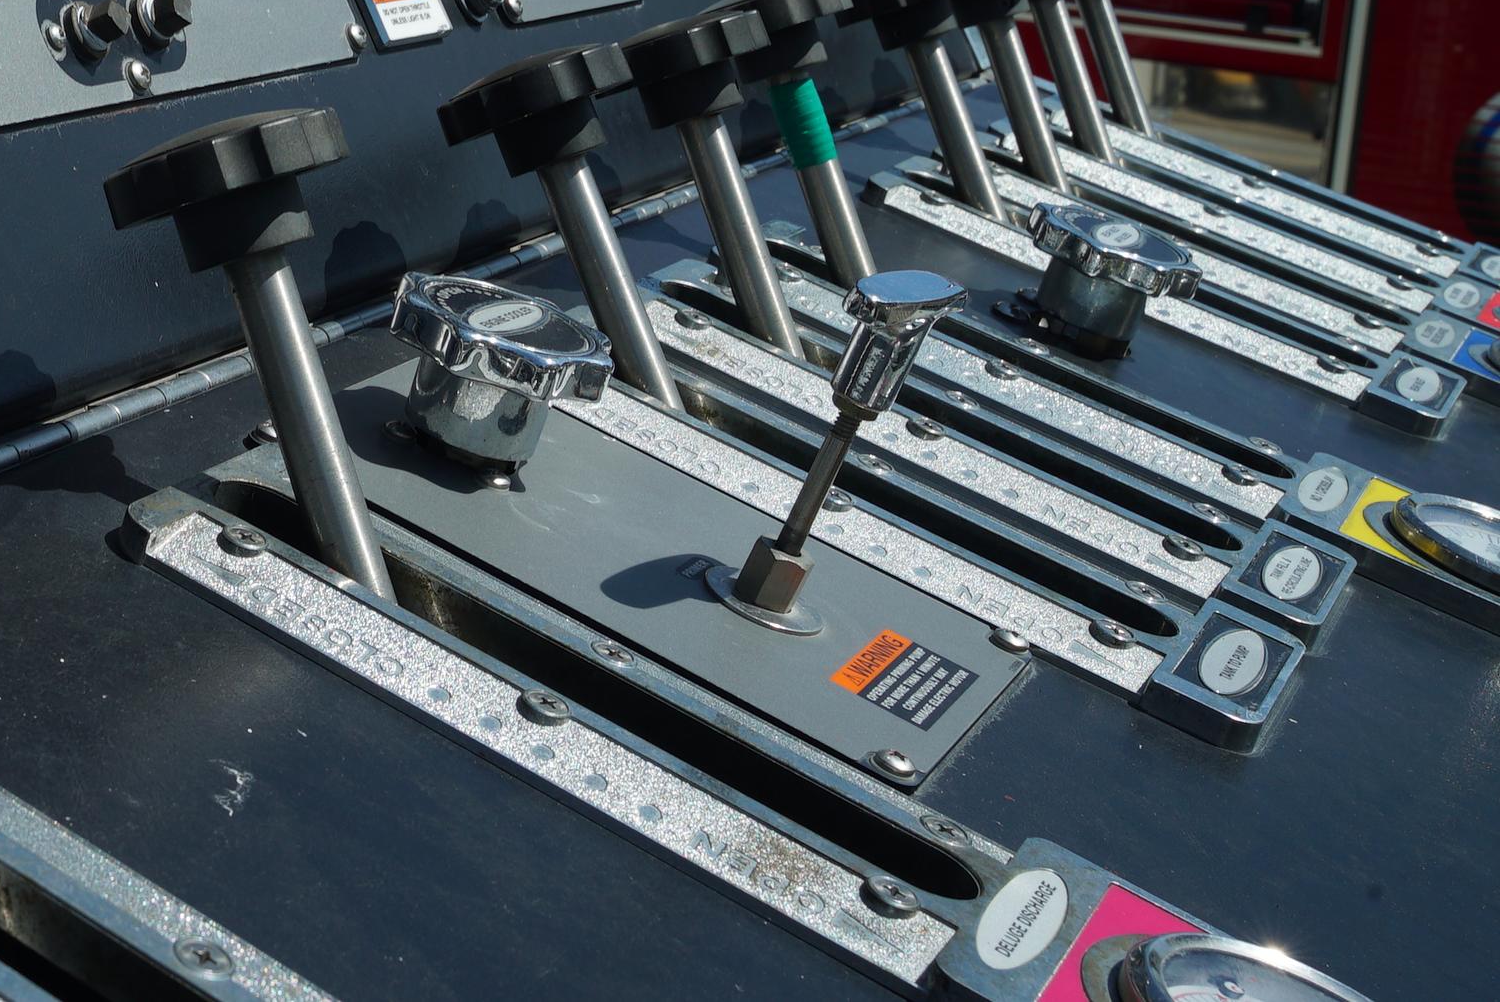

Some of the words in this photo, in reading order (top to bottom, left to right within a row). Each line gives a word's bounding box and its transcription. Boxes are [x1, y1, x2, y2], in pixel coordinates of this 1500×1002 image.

[846, 634, 904, 678] WARNING
[866, 675, 897, 701] OPERATING
[908, 647, 926, 662] PUMP
[1219, 664, 1238, 680] TANK
[1227, 658, 1242, 669] TO
[1232, 645, 1250, 662] PUMP
[881, 697, 898, 709] FOR
[890, 684, 910, 700] MORE
[903, 673, 922, 688] THAN
[917, 654, 940, 674] MINUTE
[902, 676, 940, 711] CONTINUOUSLY
[933, 667, 949, 680] MAY
[911, 703, 936, 725] DAMAGE
[929, 683, 955, 707] ELECTRIC
[948, 669, 969, 688] MOTOR
[994, 920, 1024, 958] DELUGE
[1019, 880, 1057, 928] DISCHARGE
